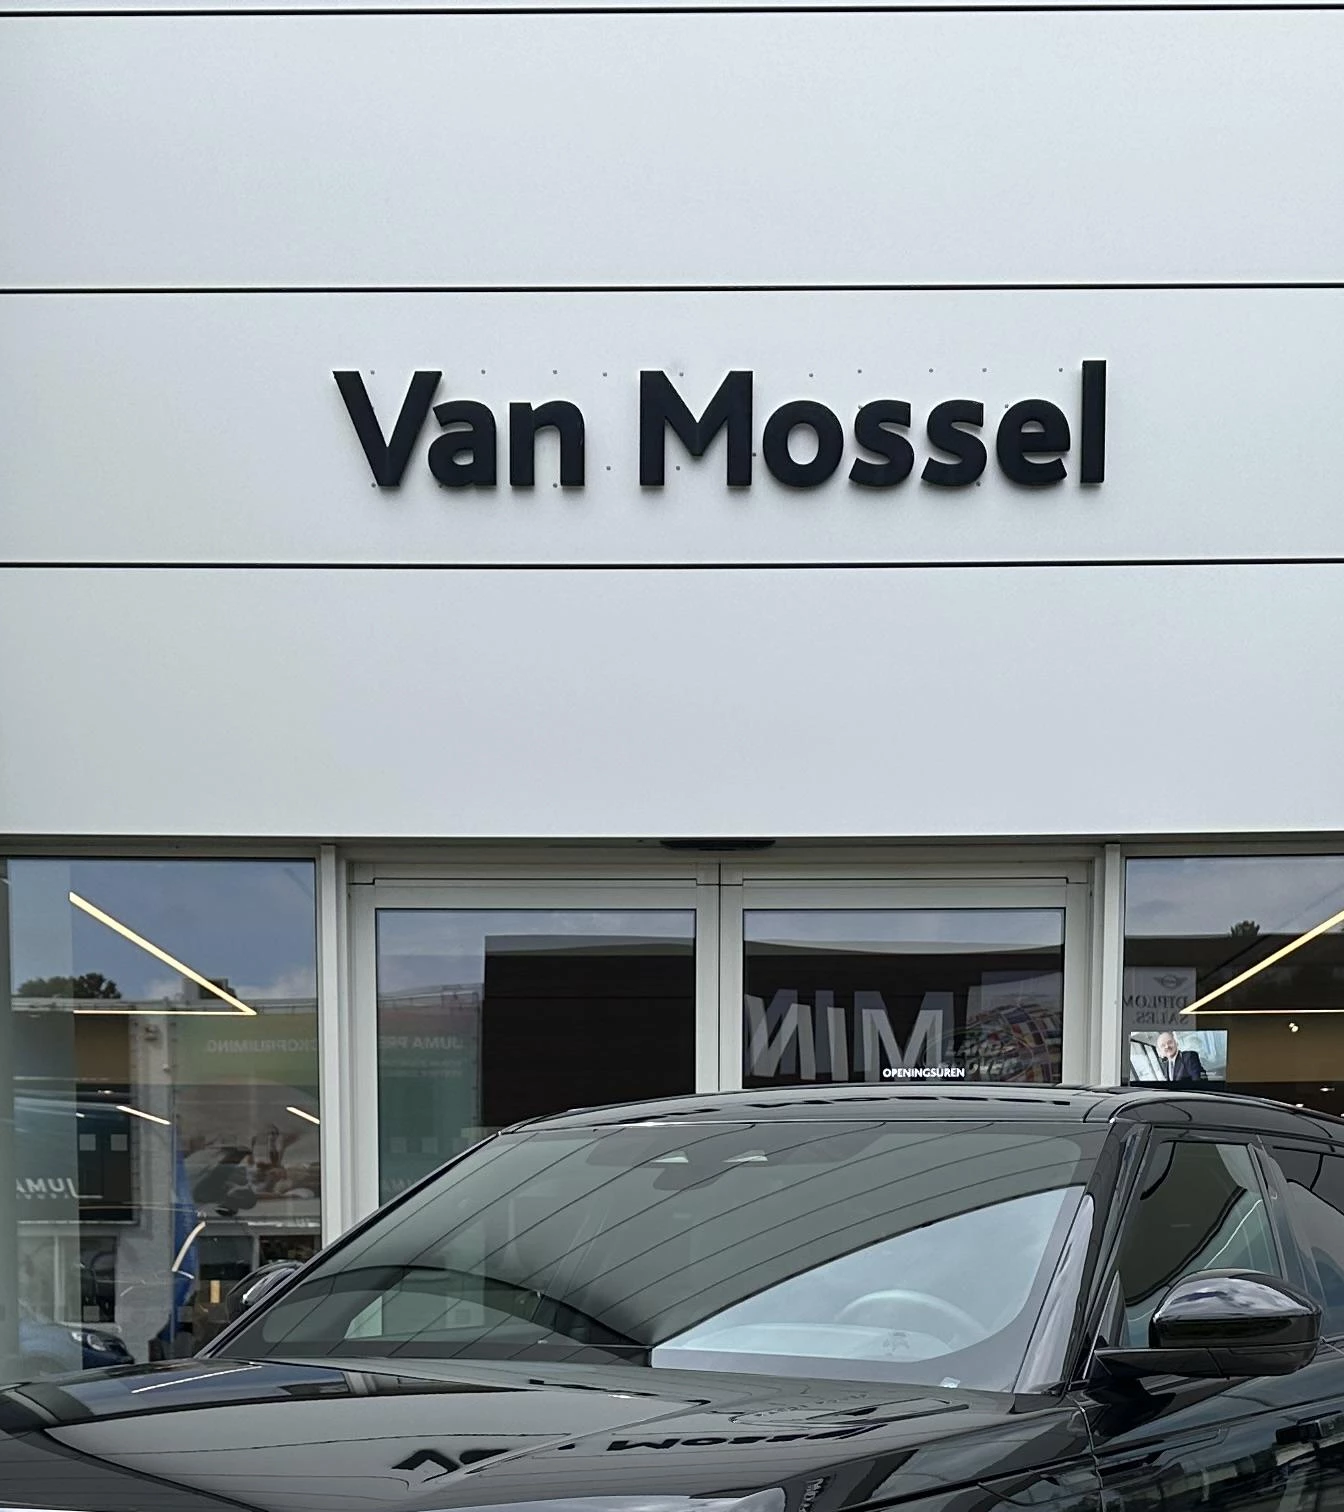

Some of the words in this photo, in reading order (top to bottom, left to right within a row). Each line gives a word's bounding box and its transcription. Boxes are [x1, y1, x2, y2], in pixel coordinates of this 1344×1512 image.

[332, 369, 585, 487] Van
[639, 360, 1107, 488] Mossel
[882, 1067, 965, 1078] OPENINGSUREN
